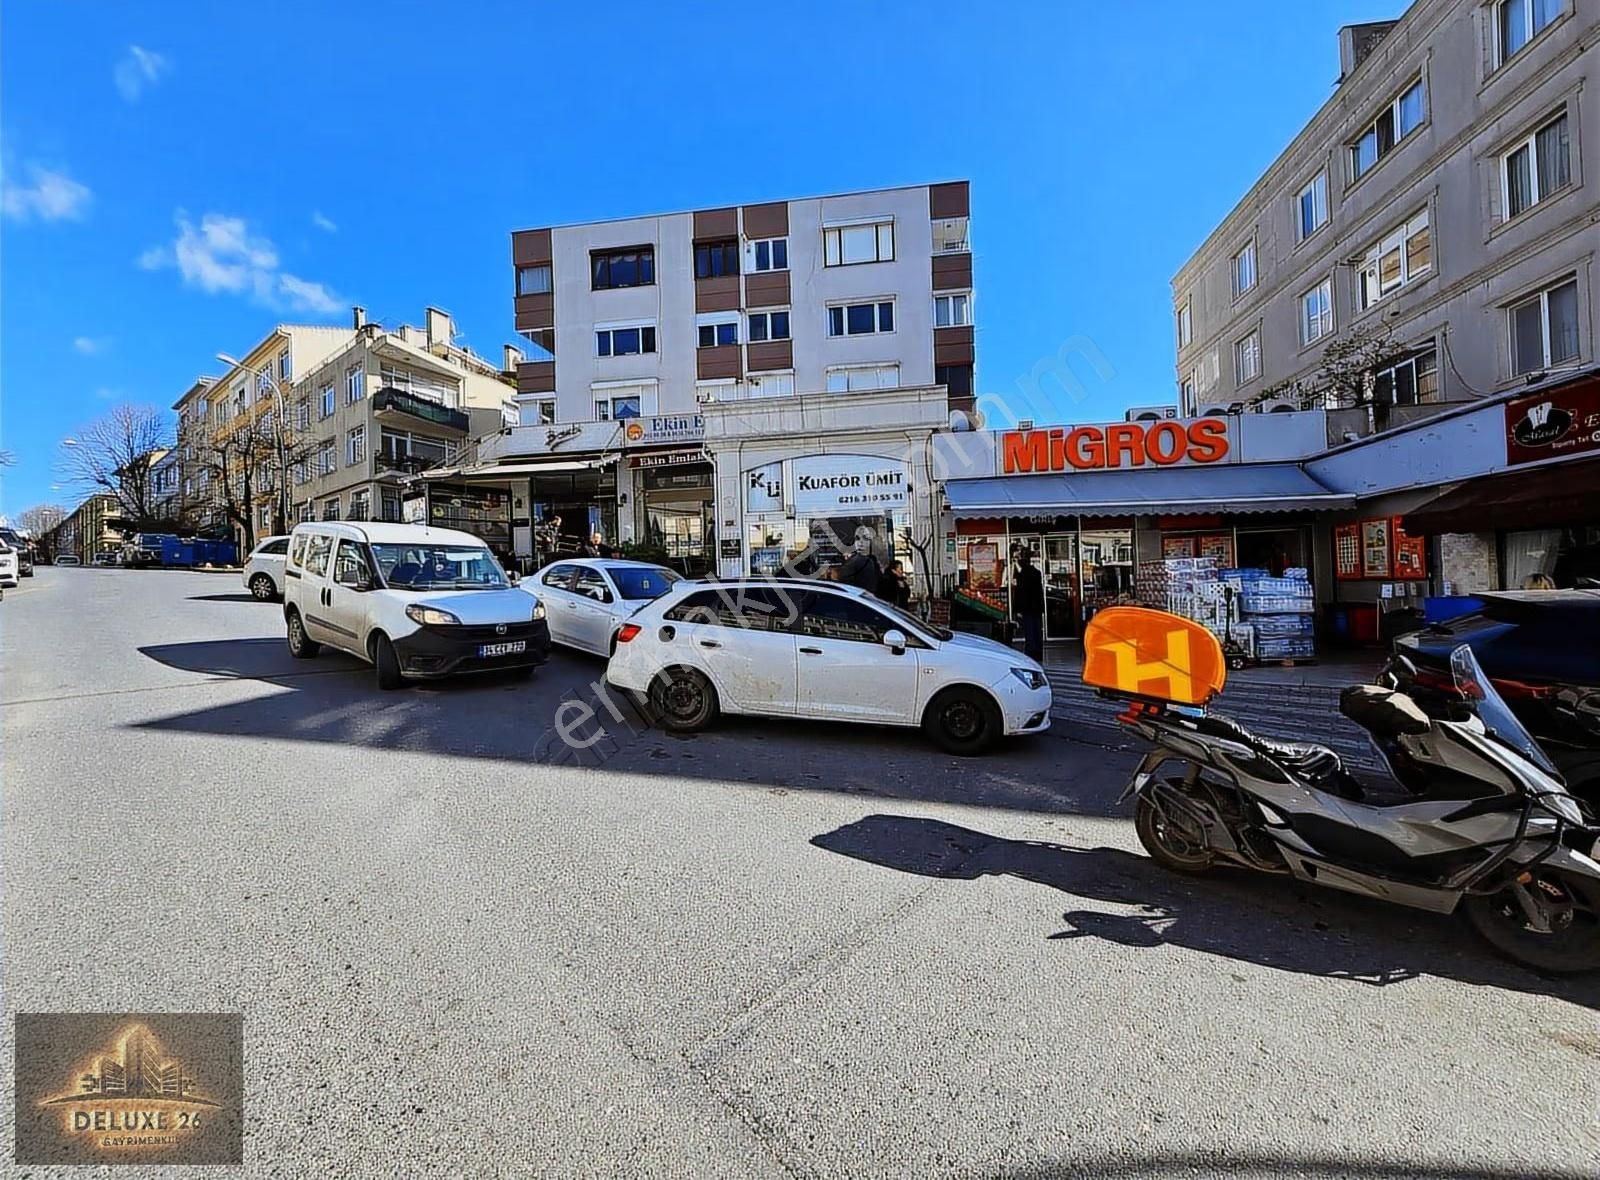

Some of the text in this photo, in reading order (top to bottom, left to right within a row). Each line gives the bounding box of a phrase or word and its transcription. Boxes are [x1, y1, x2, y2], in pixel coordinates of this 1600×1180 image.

[652, 418, 688, 431] Ekin
[640, 457, 666, 466] Ekin
[799, 474, 860, 491] KUAFÖR
